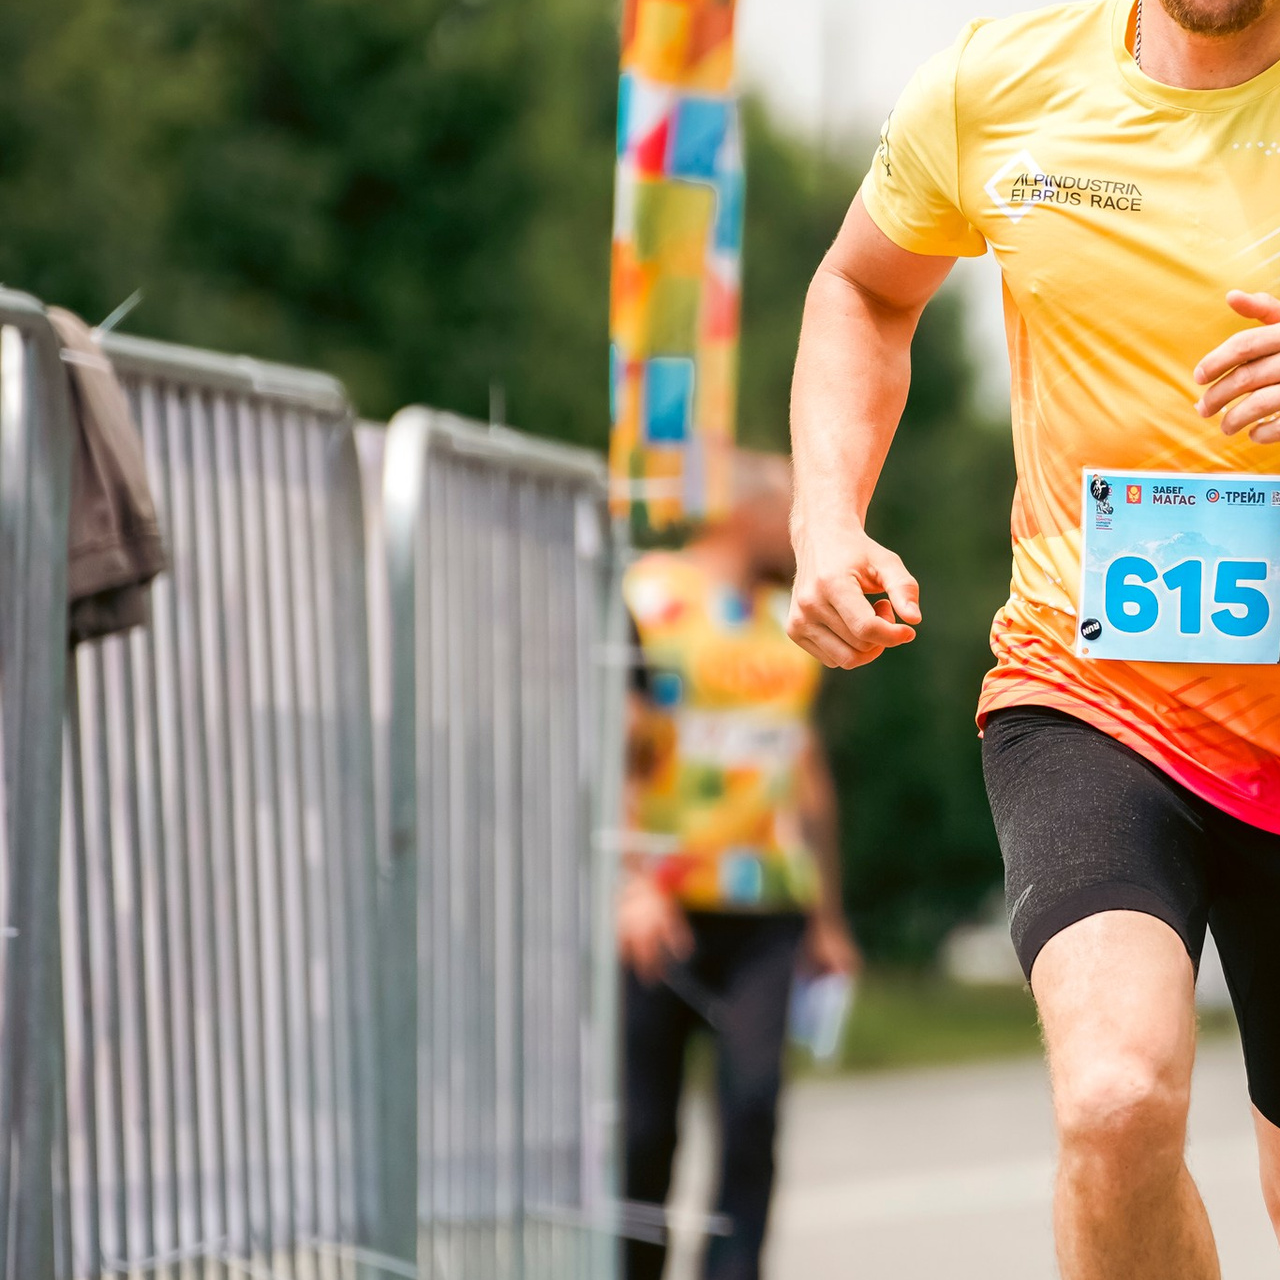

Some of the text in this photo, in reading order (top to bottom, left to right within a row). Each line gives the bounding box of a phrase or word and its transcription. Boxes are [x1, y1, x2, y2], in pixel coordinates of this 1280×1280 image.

[1010, 188, 1142, 212] ELBRUS RACE
[1152, 485, 1184, 495] ЗАБЕГ
[1152, 494, 1196, 506] МАГАС
[1105, 555, 1270, 638] 615
